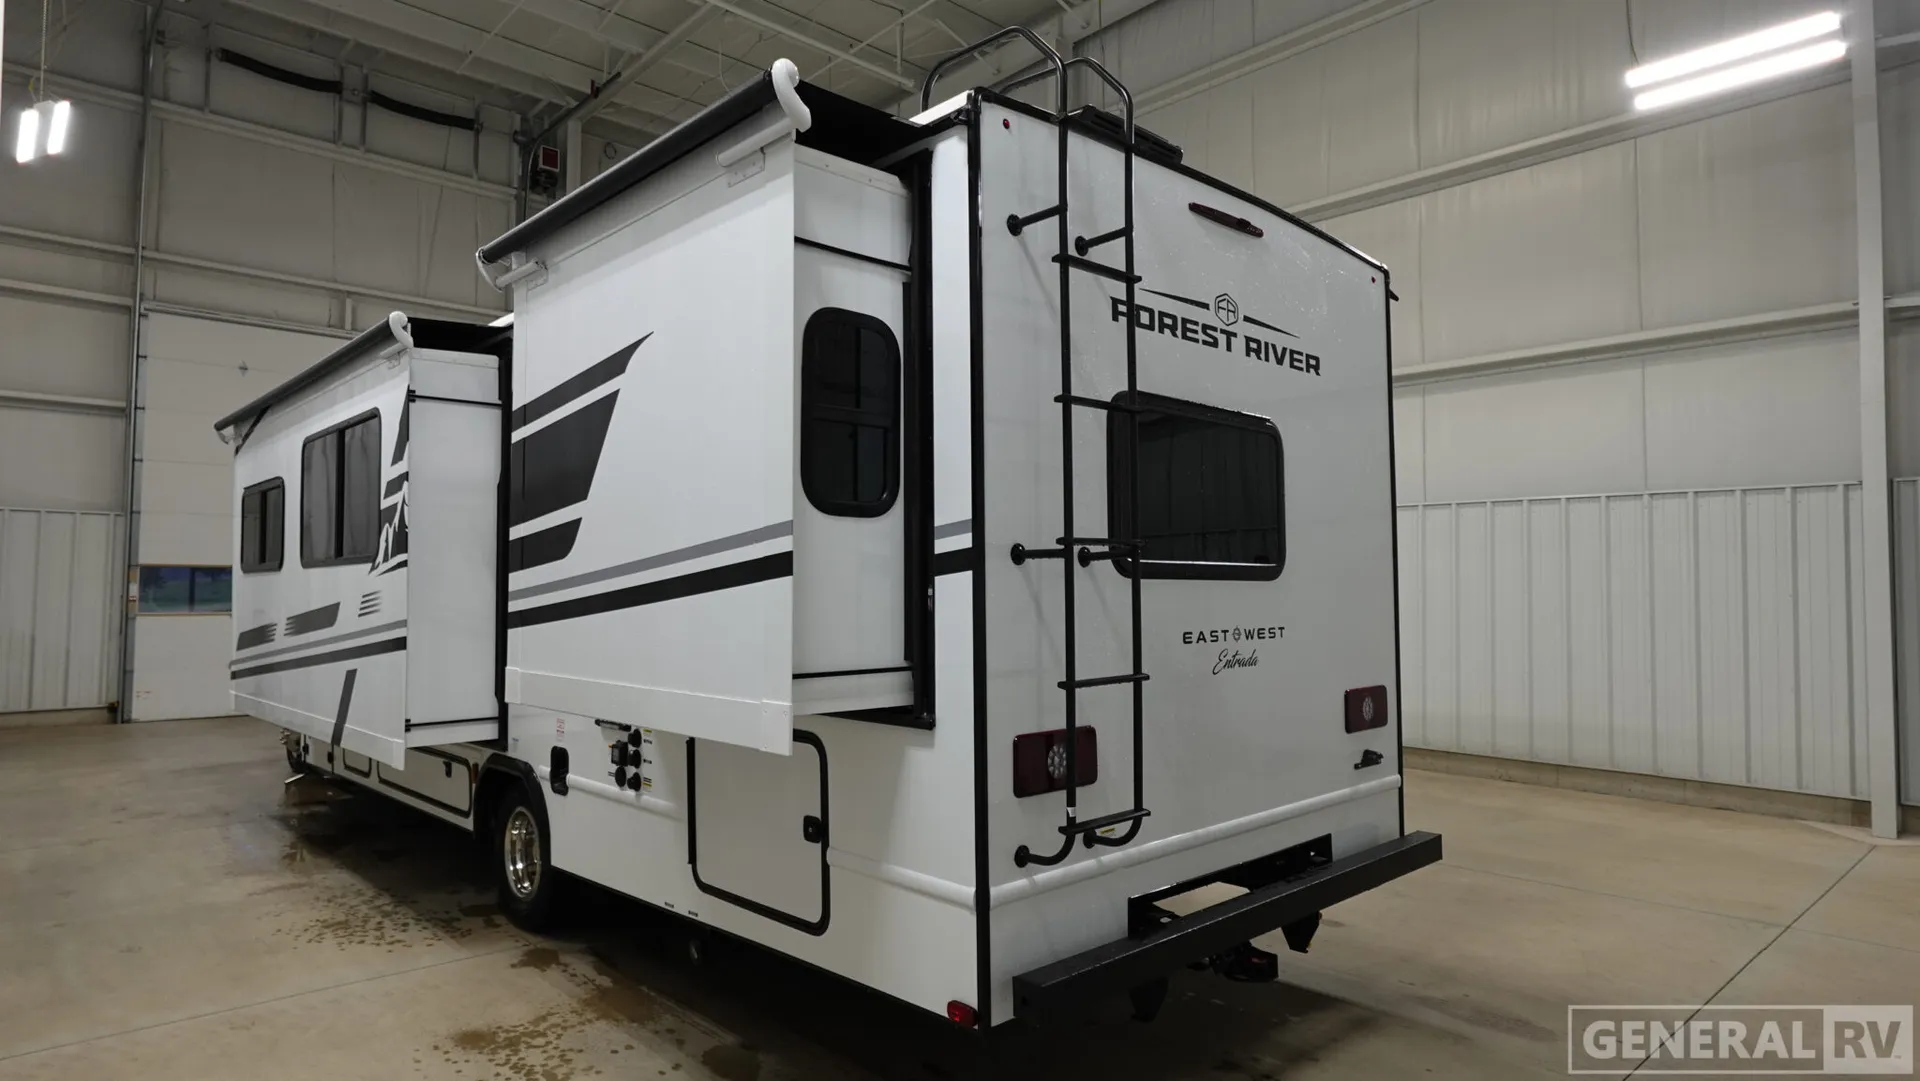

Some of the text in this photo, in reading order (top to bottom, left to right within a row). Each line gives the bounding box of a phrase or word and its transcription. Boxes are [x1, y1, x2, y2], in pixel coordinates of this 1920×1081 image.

[1109, 296, 1321, 376] FOREST RIVER
[1182, 626, 1286, 645] EAST WEST
[1212, 648, 1259, 676] Entrada
